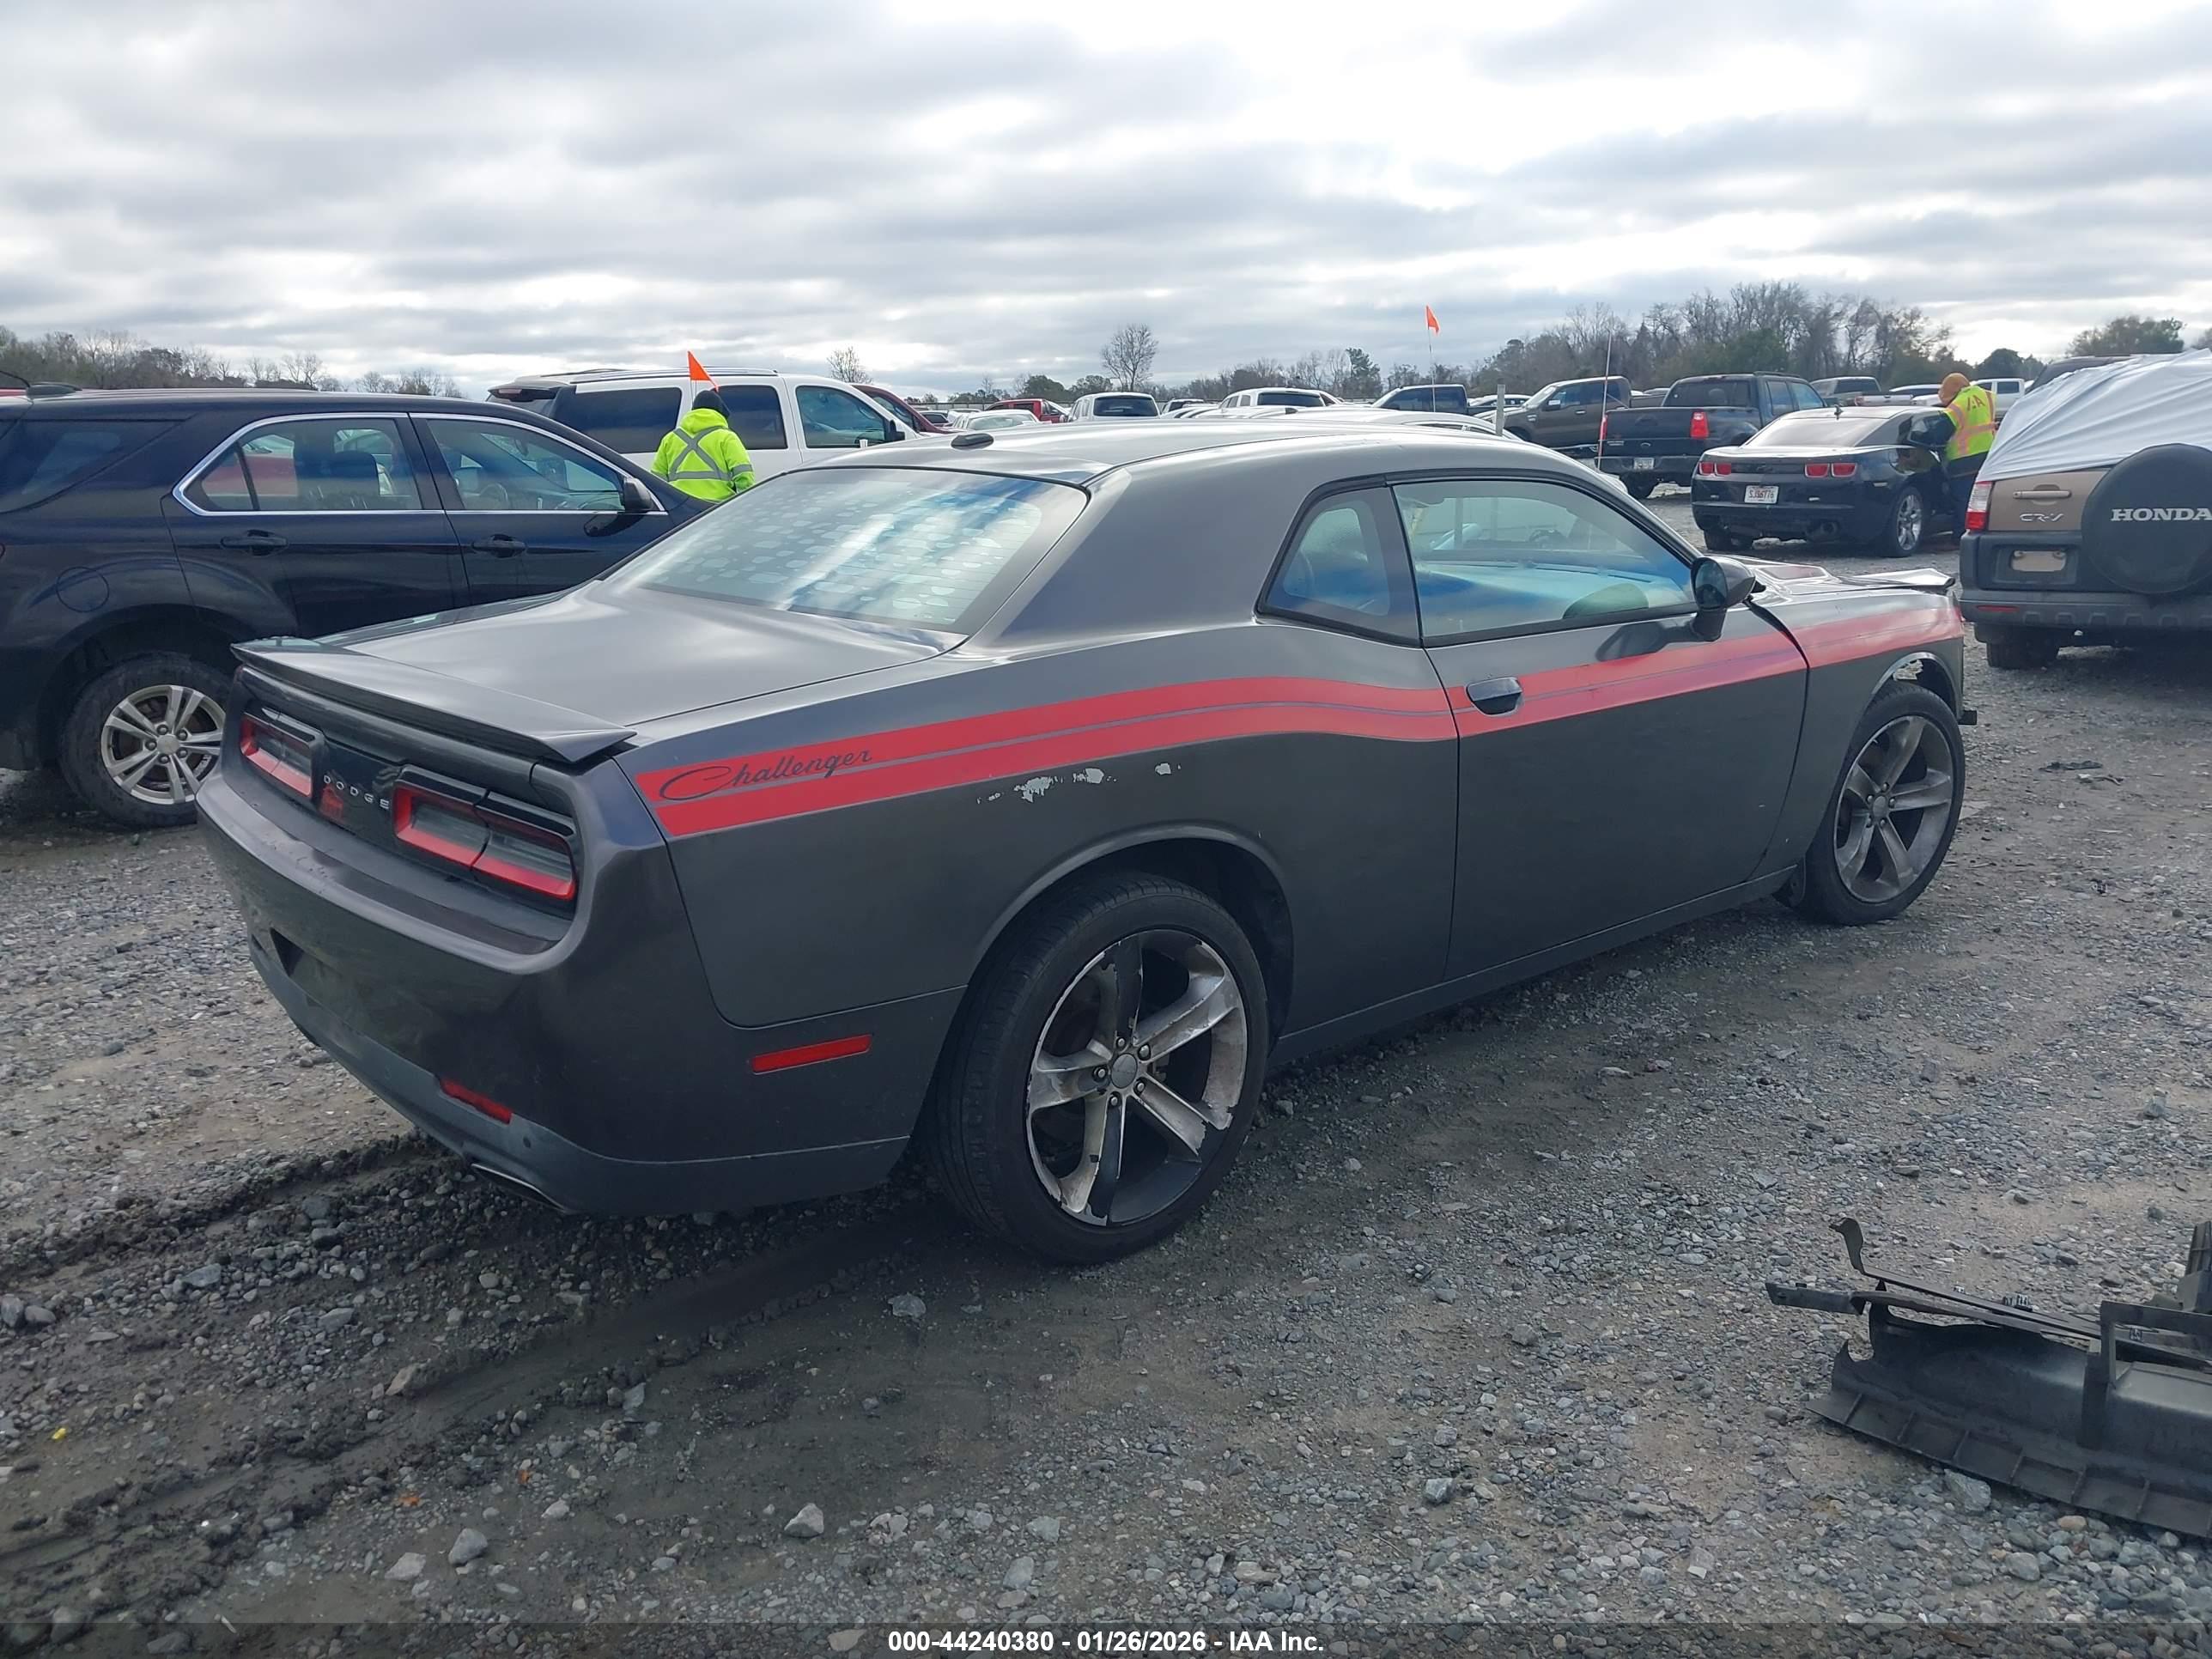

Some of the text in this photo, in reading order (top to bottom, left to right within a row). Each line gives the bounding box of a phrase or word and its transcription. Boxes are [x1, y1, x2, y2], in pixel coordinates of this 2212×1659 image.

[2019, 513, 2064, 523] CR-V
[2110, 507, 2212, 521] HONDA
[659, 750, 872, 801] Challenger
[323, 775, 390, 810] DODGE
